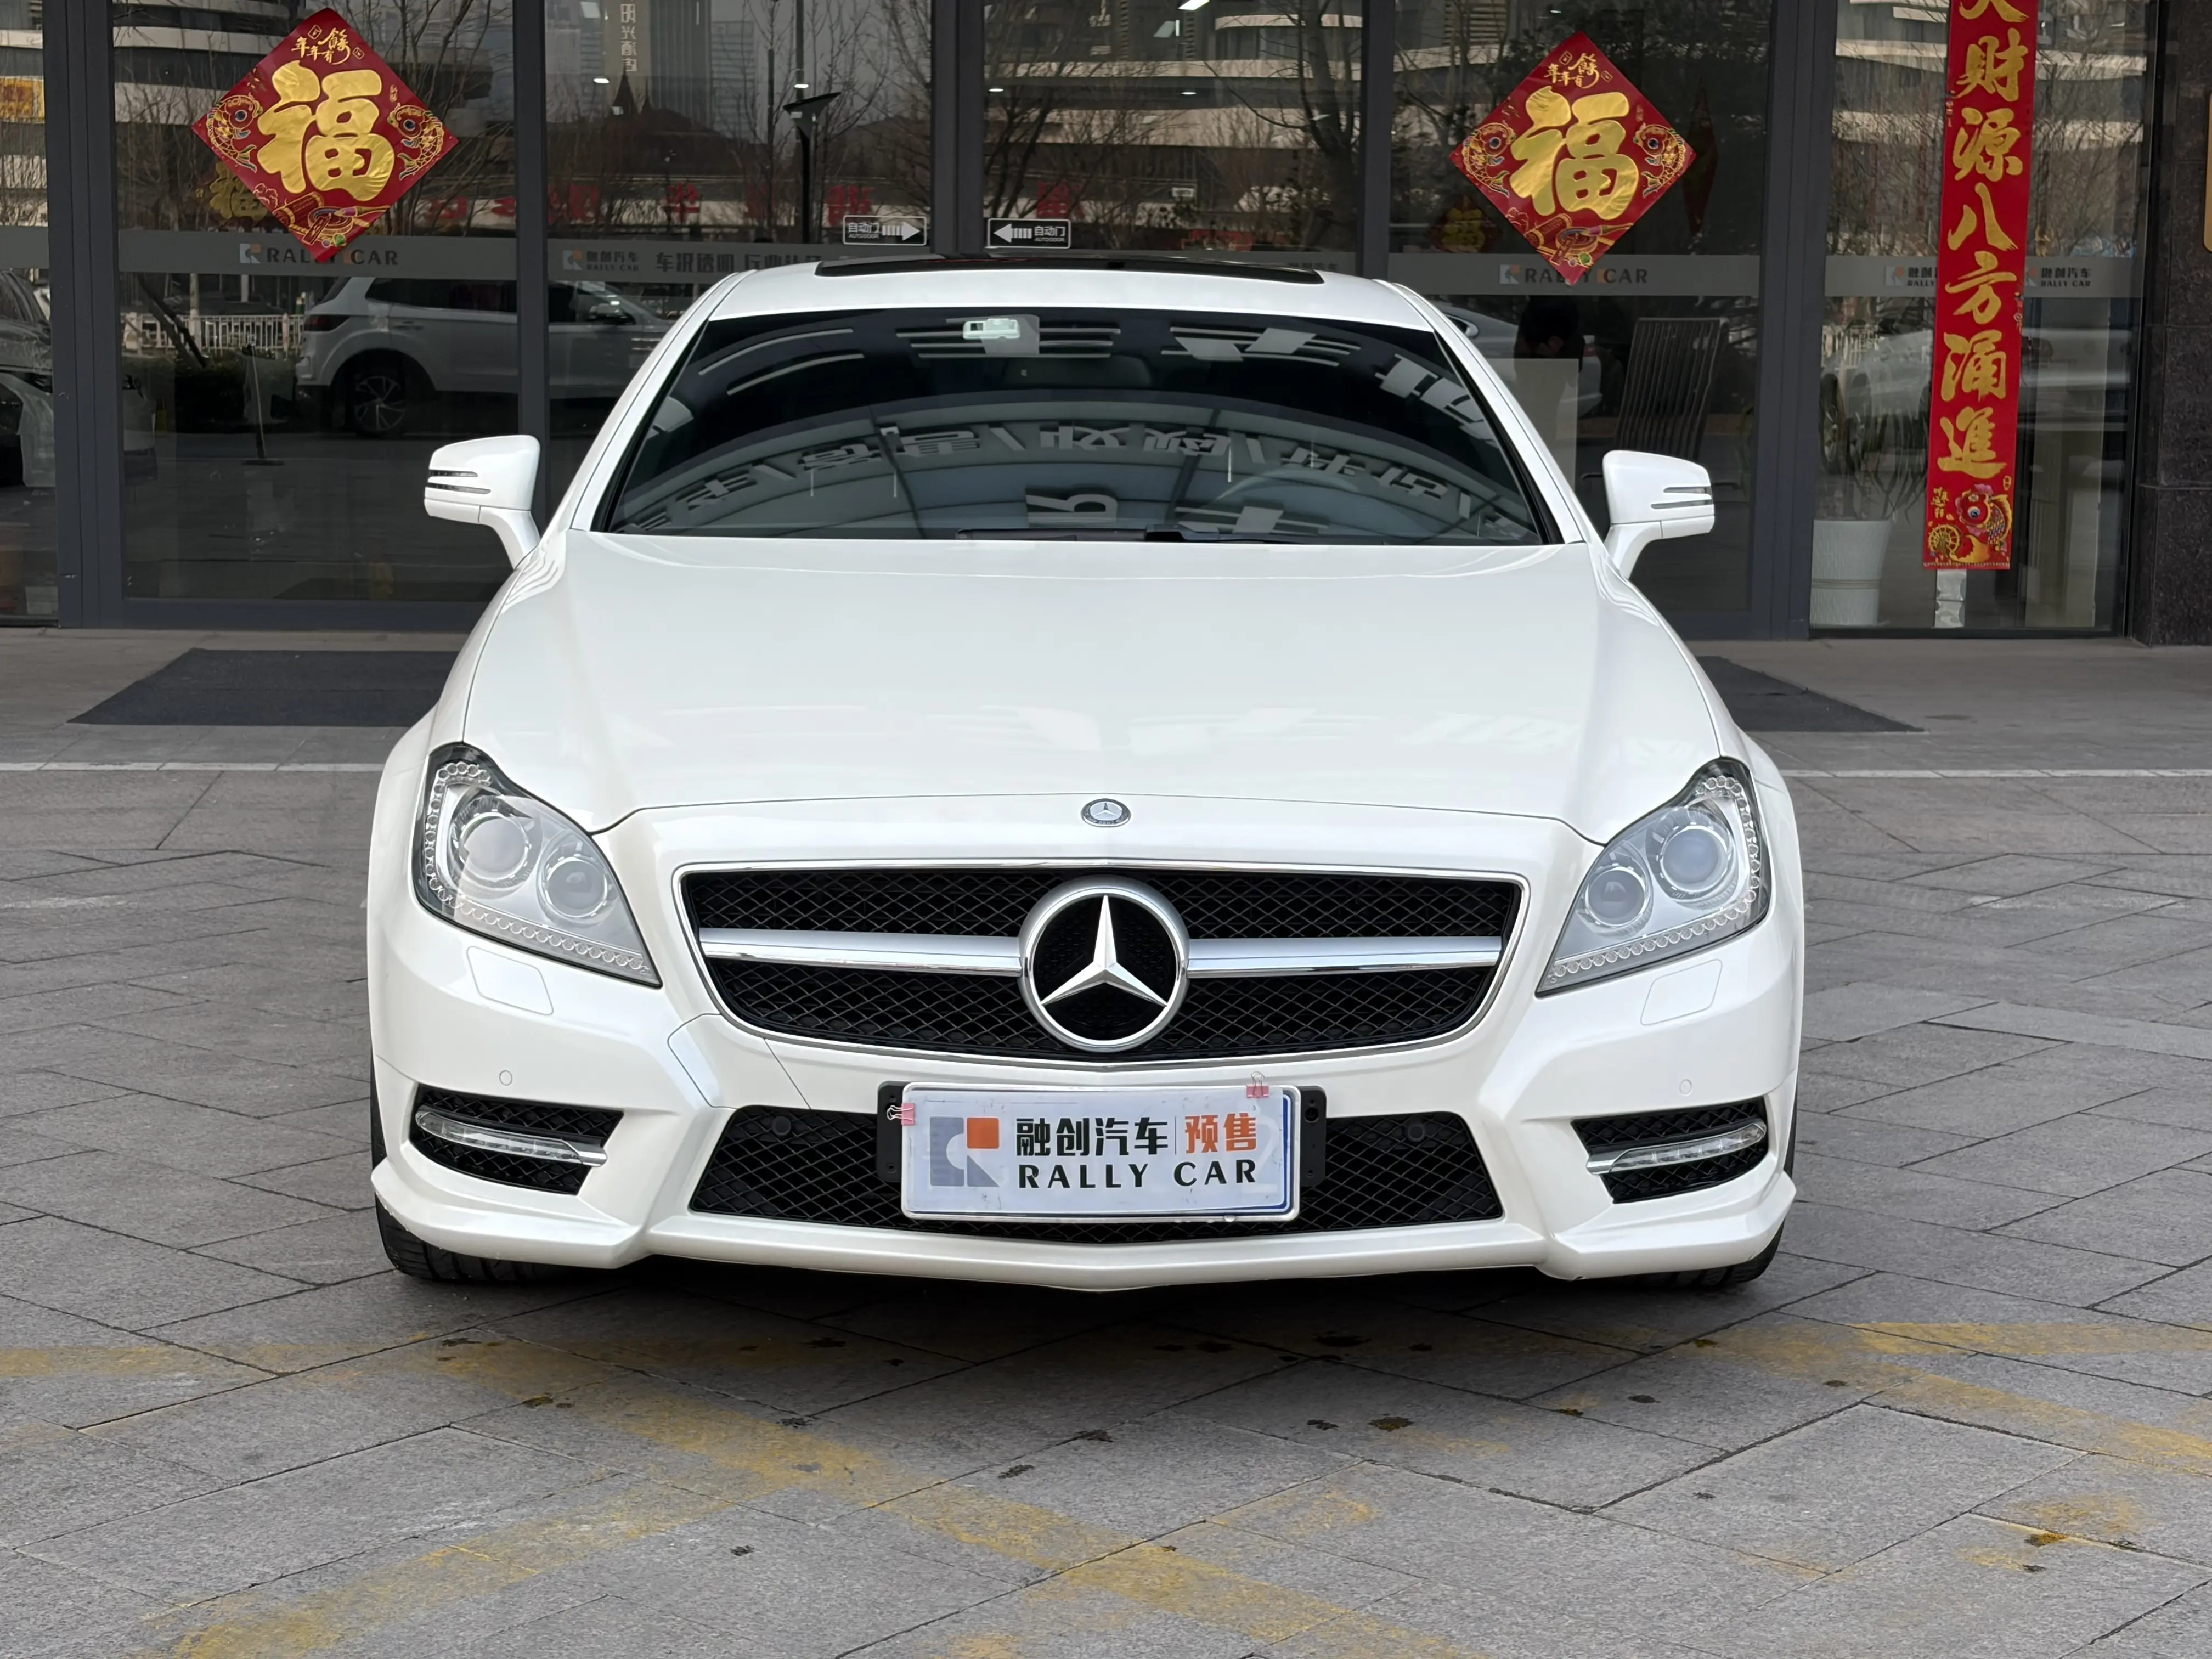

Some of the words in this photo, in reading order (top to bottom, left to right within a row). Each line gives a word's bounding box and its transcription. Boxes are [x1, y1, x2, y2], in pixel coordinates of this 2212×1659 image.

[257, 60, 395, 202] 福
[1509, 86, 1639, 220] 福
[849, 222, 879, 233] 自动门
[1034, 225, 1065, 236] 自动门
[267, 247, 335, 263] RAL
[350, 249, 398, 265] CAR
[1602, 268, 1648, 284] CAR
[1016, 1117, 1169, 1156] 融创汽车
[1184, 1111, 1257, 1153] 预售
[1019, 1163, 1148, 1189] RALLY
[1175, 1159, 1257, 1187] CAR
